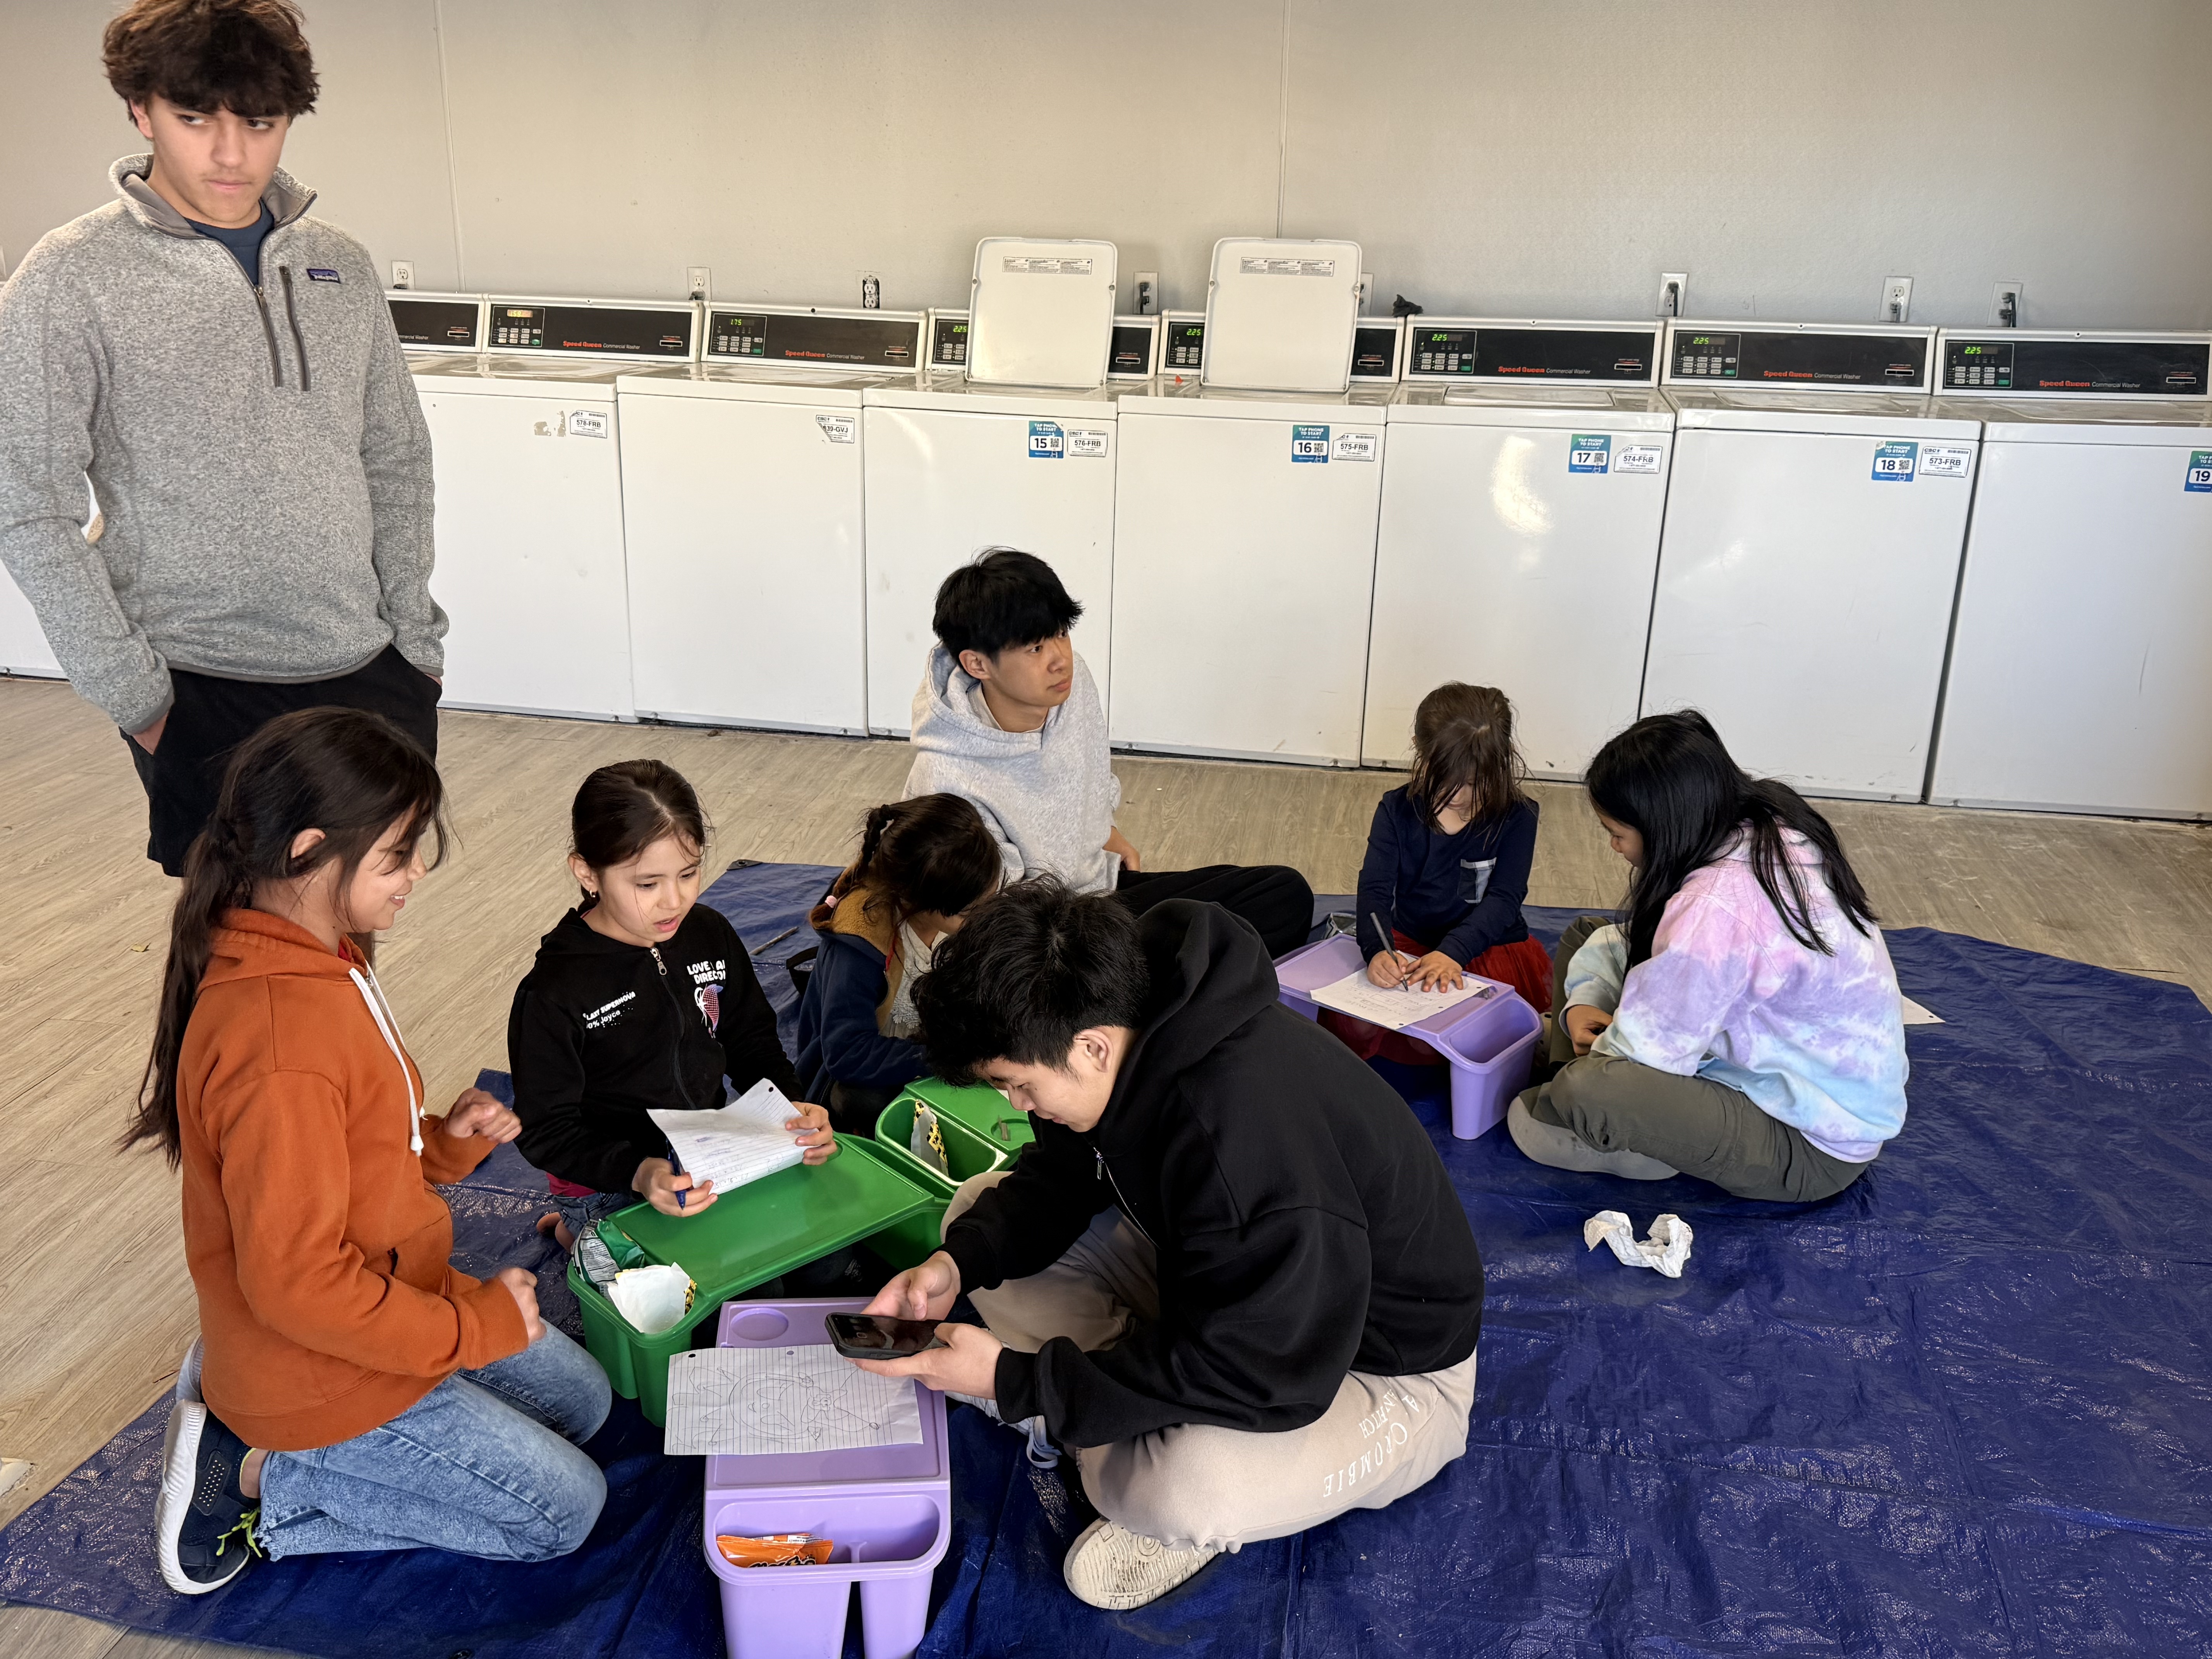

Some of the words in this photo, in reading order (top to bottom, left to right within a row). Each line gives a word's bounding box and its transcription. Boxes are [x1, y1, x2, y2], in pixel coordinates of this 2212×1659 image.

[1034, 438, 1047, 448] 15
[1298, 442, 1312, 453] 16
[1577, 452, 1591, 463] 17
[1929, 457, 1961, 465] 573-FRB
[1881, 459, 1896, 471] 18
[2195, 470, 2211, 482] 19
[687, 960, 711, 975] LOVE
